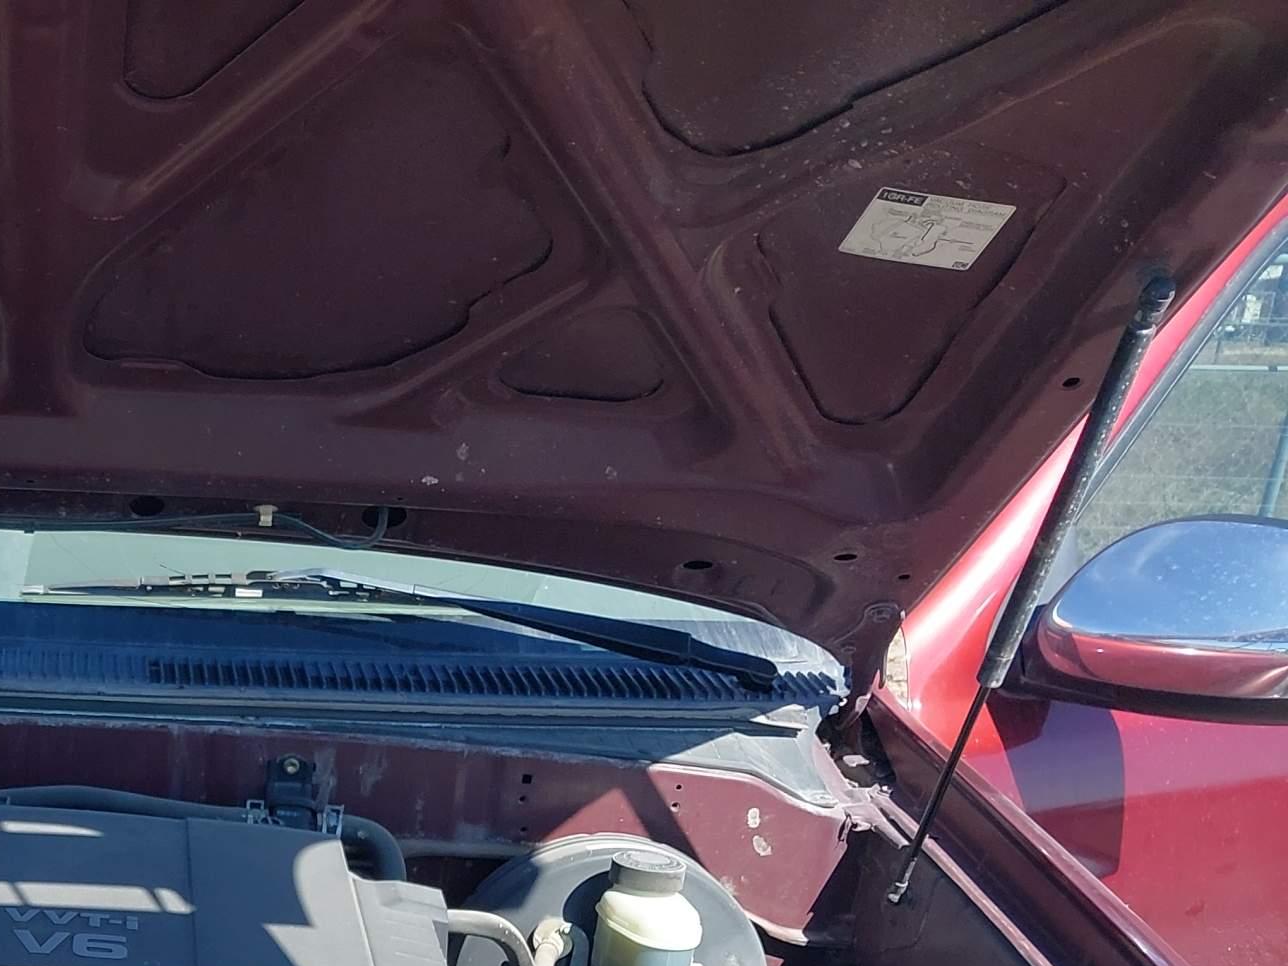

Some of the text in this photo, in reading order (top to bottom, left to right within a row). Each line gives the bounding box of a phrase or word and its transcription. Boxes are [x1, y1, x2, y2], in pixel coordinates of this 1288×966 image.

[882, 191, 923, 205] 1GR-FE
[5, 907, 139, 931] VVT-i
[13, 929, 128, 960] V6
